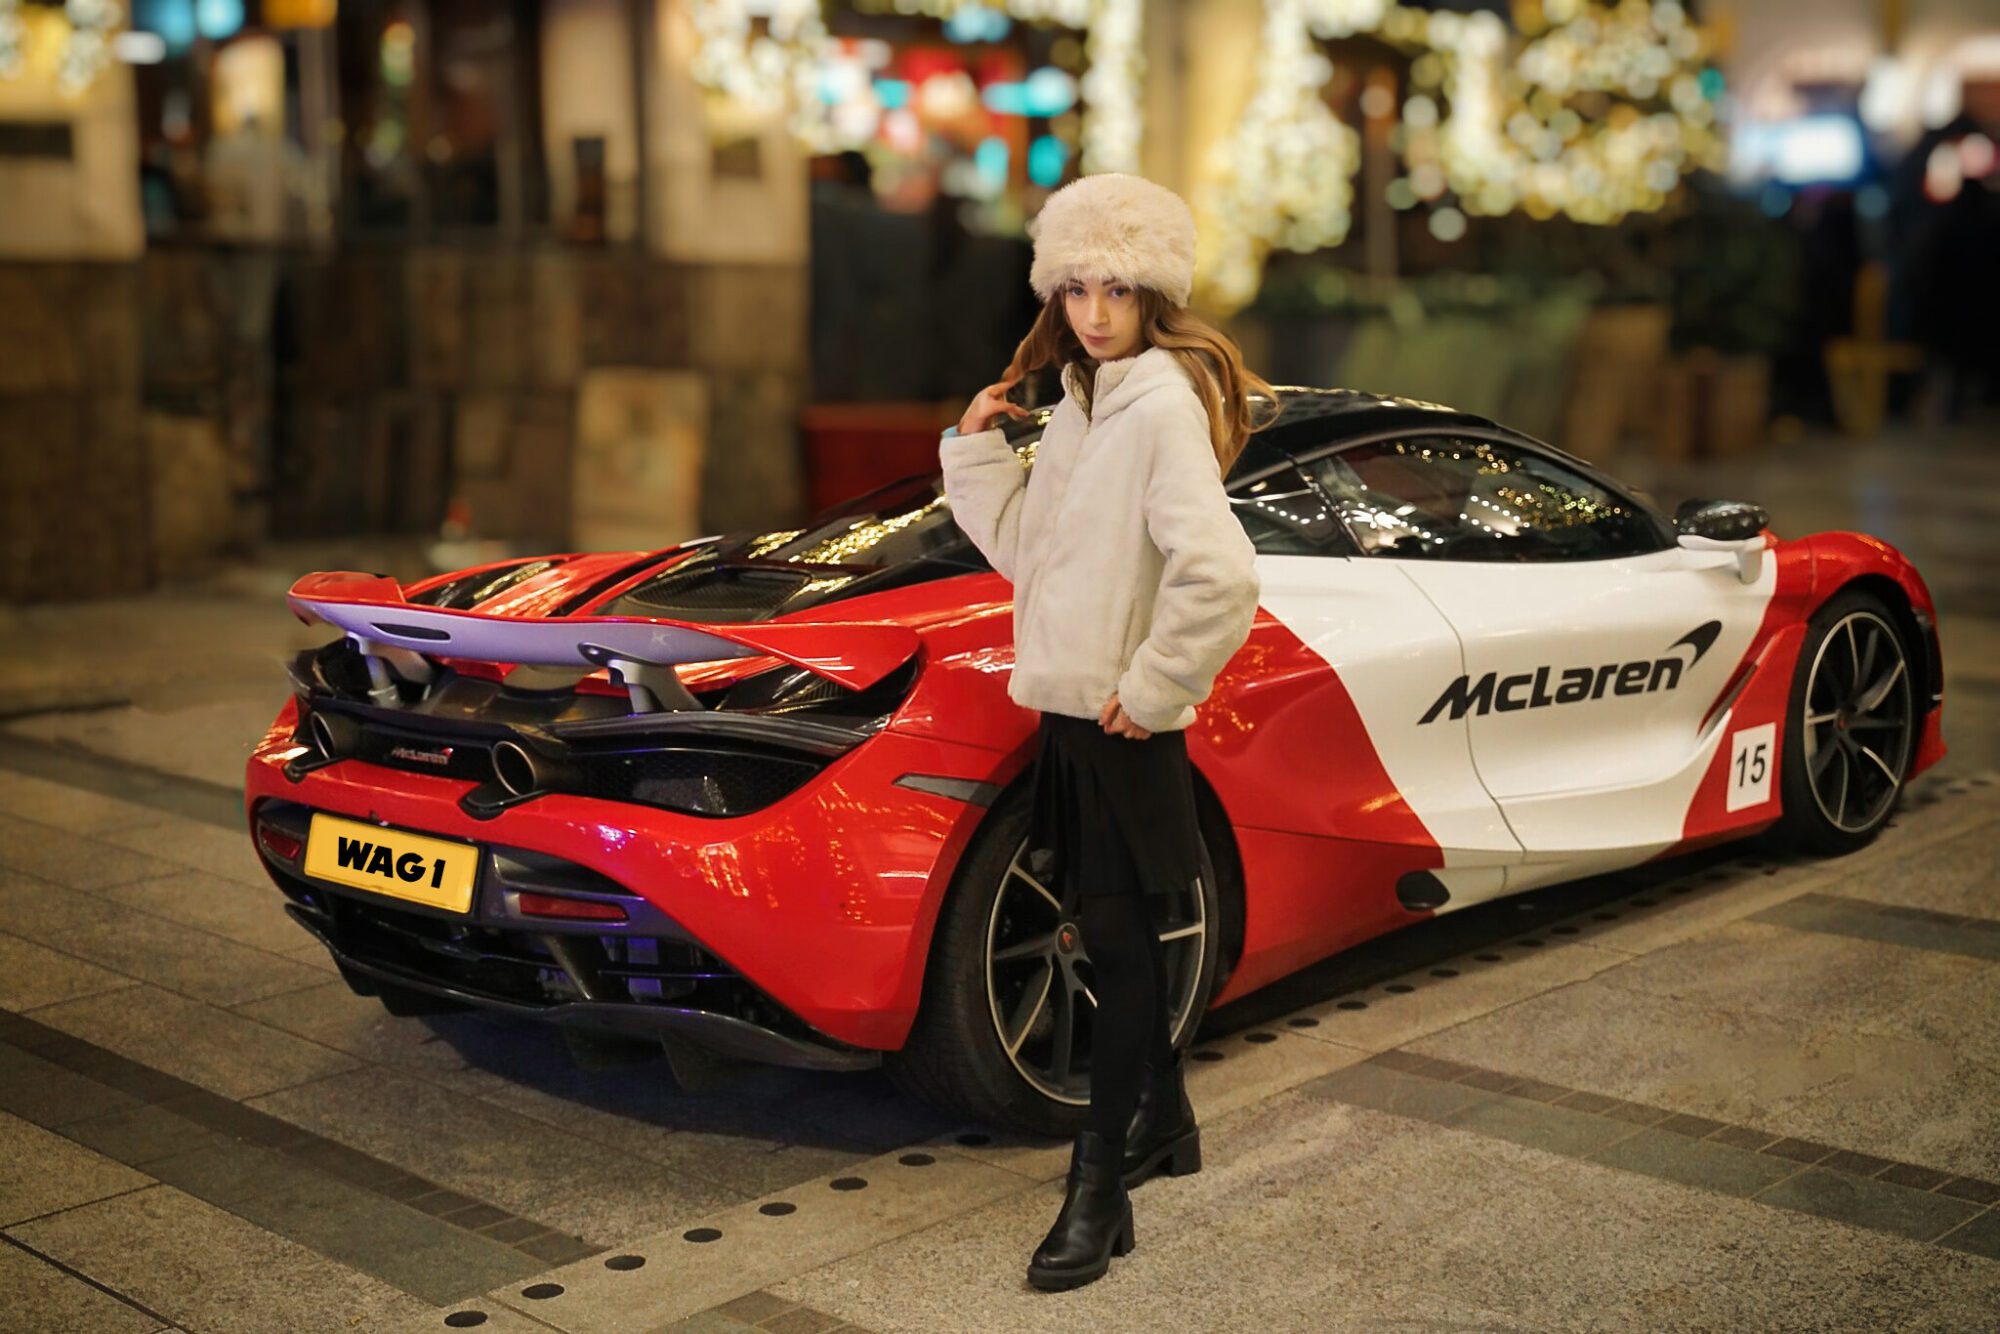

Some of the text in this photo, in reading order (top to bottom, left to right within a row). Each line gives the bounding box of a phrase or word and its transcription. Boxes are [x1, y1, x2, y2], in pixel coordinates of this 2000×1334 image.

[1417, 657, 1684, 726] McLaren
[1736, 744, 1767, 788] 15
[338, 836, 426, 882] WAG
